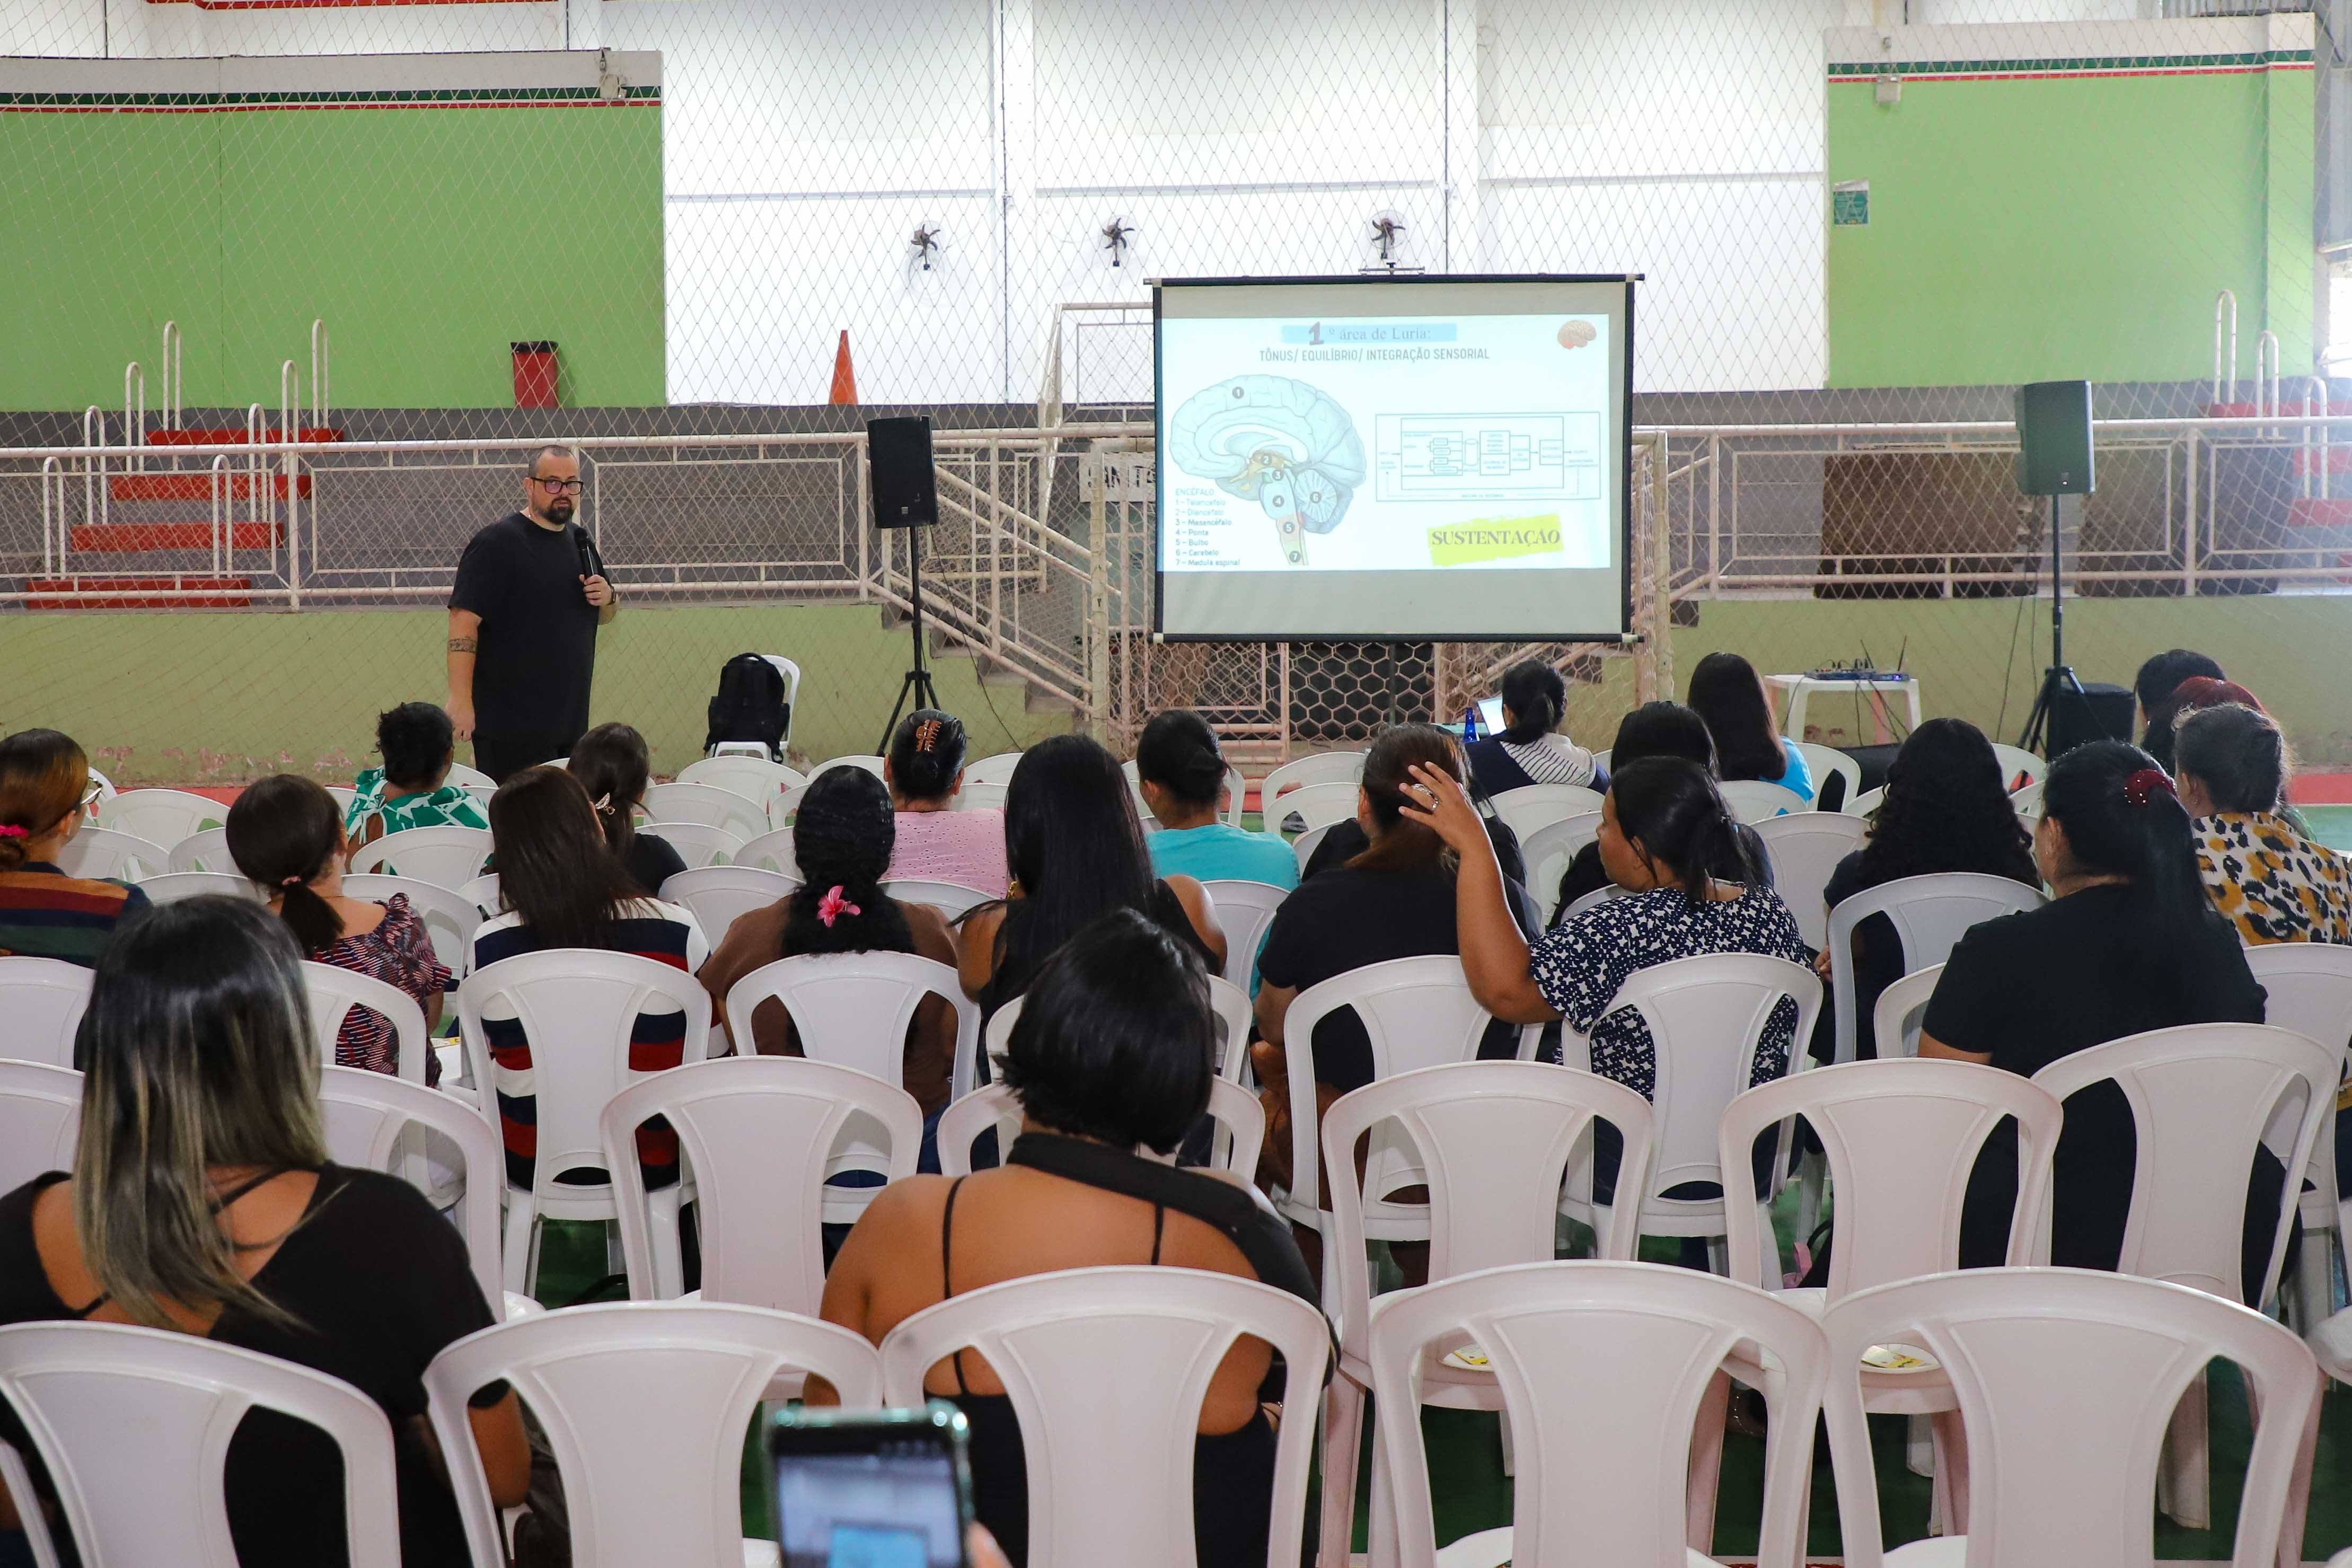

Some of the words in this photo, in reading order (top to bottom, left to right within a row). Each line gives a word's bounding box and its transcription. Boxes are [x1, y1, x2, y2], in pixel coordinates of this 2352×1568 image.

[1308, 321, 1324, 345] 1
[1339, 325, 1366, 340] área
[1371, 325, 1387, 340] de
[1391, 323, 1431, 340] Luria:
[1259, 348, 1299, 363] TÔNUS/
[1302, 347, 1362, 363] EQUILÍBRIO/
[1367, 347, 1430, 363] INTEGRAÇÃO
[1433, 348, 1490, 360] SENSORIAL
[1432, 529, 1561, 547] SUSTENTAÇÃO
